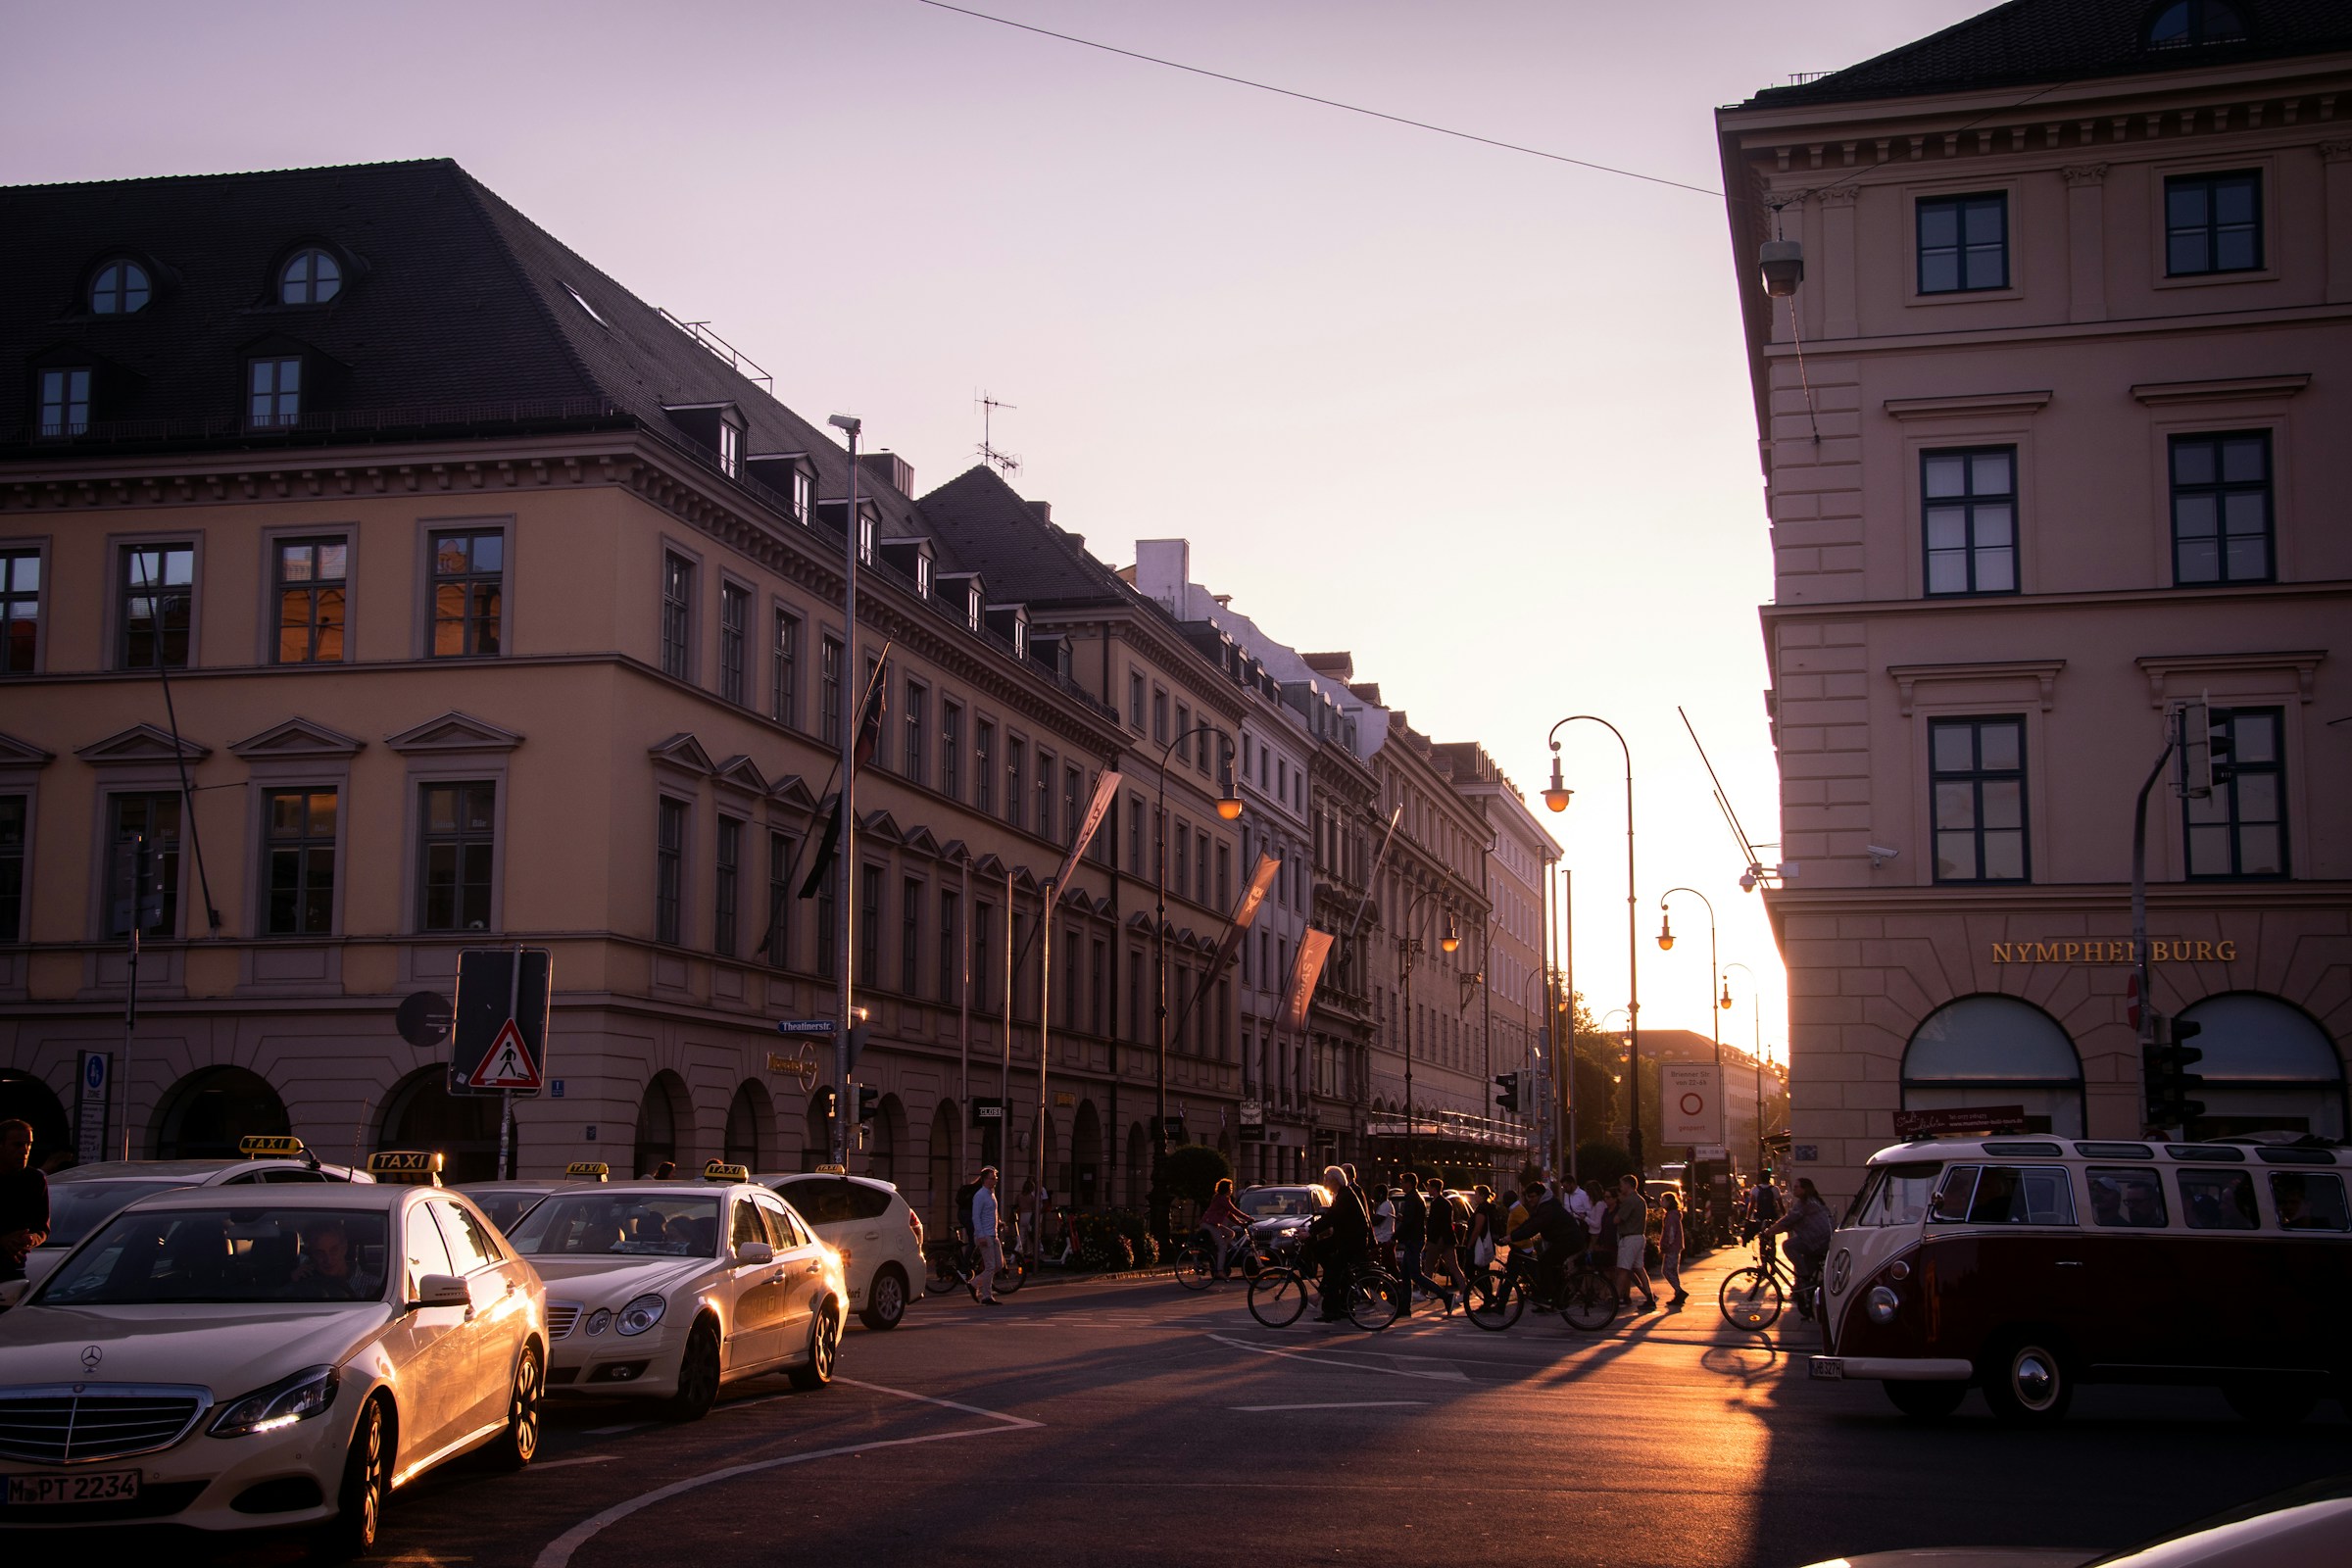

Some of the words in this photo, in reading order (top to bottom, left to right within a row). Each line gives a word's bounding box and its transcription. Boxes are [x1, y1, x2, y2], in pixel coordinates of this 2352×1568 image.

[782, 1021, 832, 1031] Theatinerstr.
[247, 1138, 285, 1149] TAXI
[379, 1154, 425, 1168] TAXI
[572, 1163, 600, 1172] TAXI
[10, 1479, 24, 1501] M
[39, 1478, 70, 1501] PT
[74, 1475, 135, 1500] 2234
